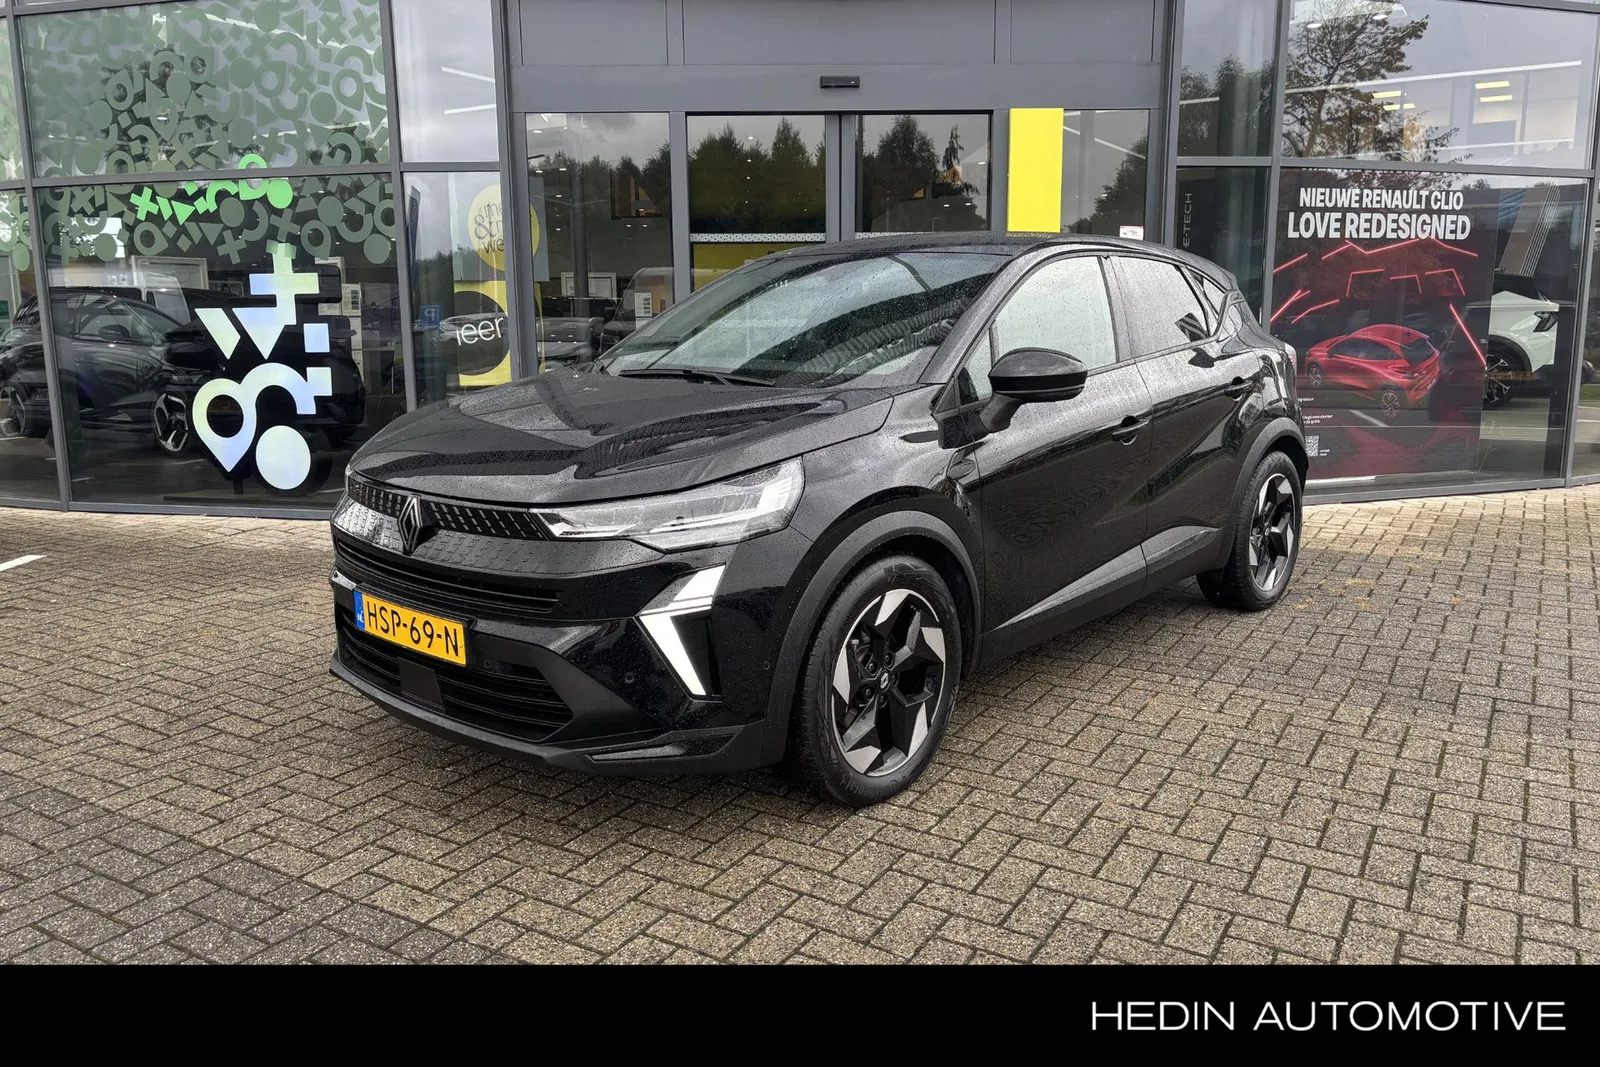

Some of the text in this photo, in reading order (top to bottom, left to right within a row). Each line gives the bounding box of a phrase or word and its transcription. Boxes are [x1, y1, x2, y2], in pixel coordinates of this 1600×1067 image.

[1299, 187, 1464, 210] NIEUWE RENAULT CLIO
[1182, 193, 1192, 248] E-TECH
[1288, 211, 1471, 240] LOVE REDESIGNED
[367, 601, 459, 657] HSP-69-N
